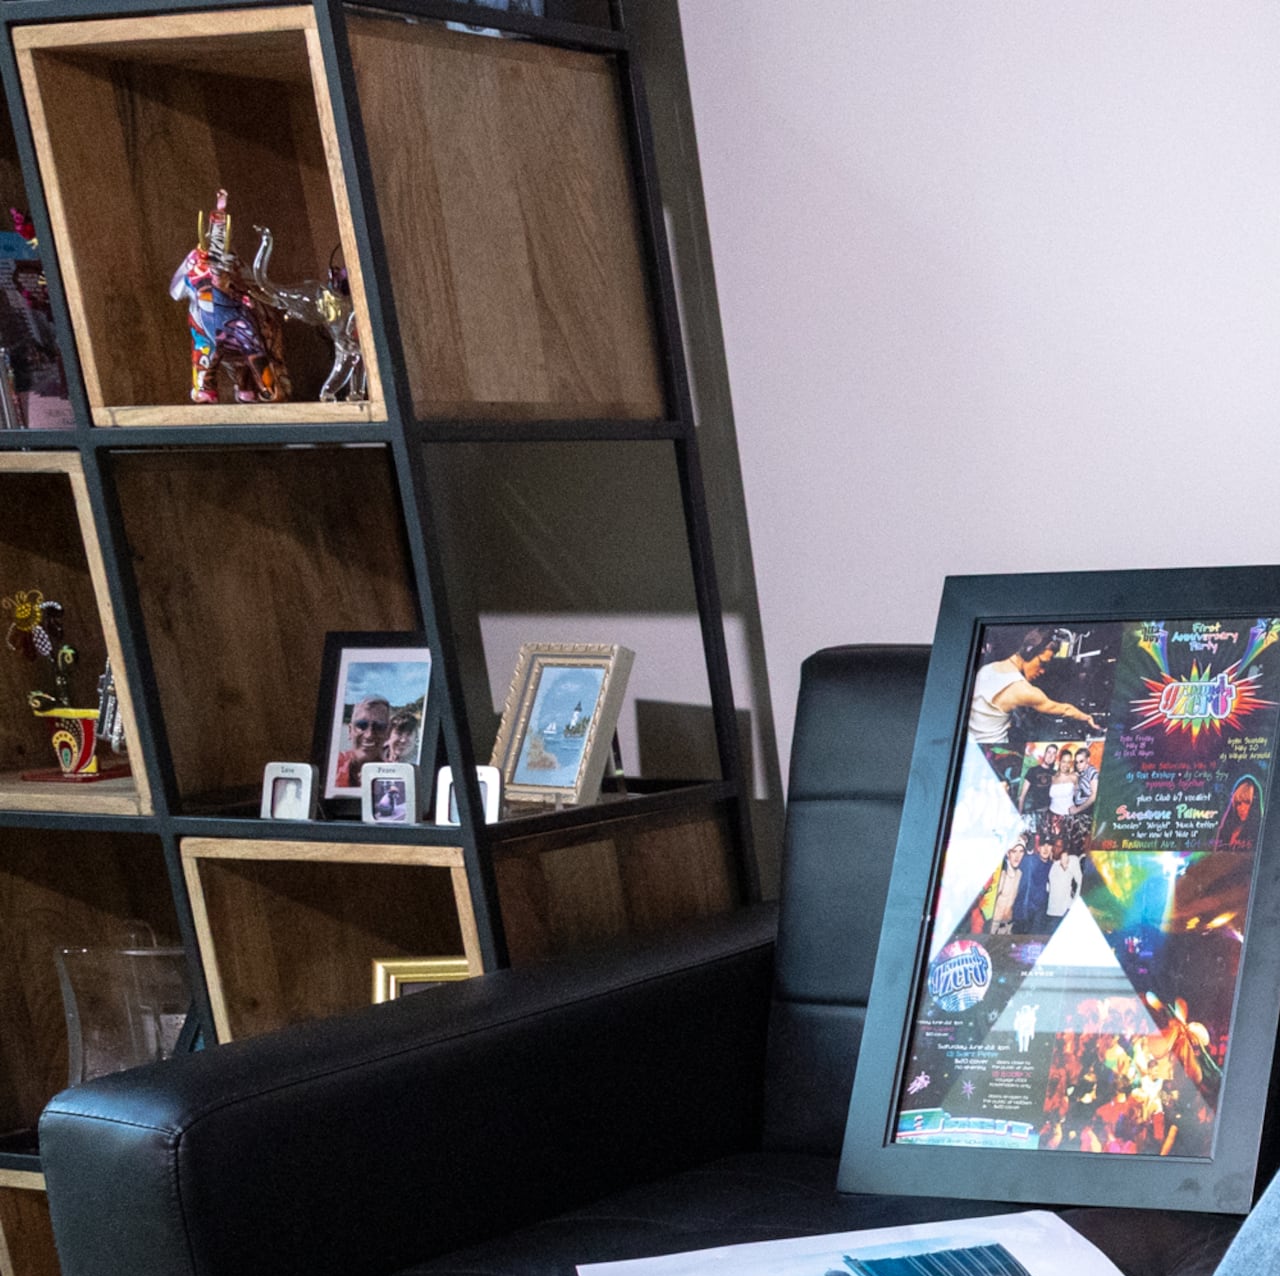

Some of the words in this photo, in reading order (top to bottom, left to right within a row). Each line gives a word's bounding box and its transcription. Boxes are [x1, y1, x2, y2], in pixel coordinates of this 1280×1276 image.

[1192, 622, 1221, 633] First
[1171, 631, 1239, 643] Anniversary
[1154, 793, 1171, 801] Club
